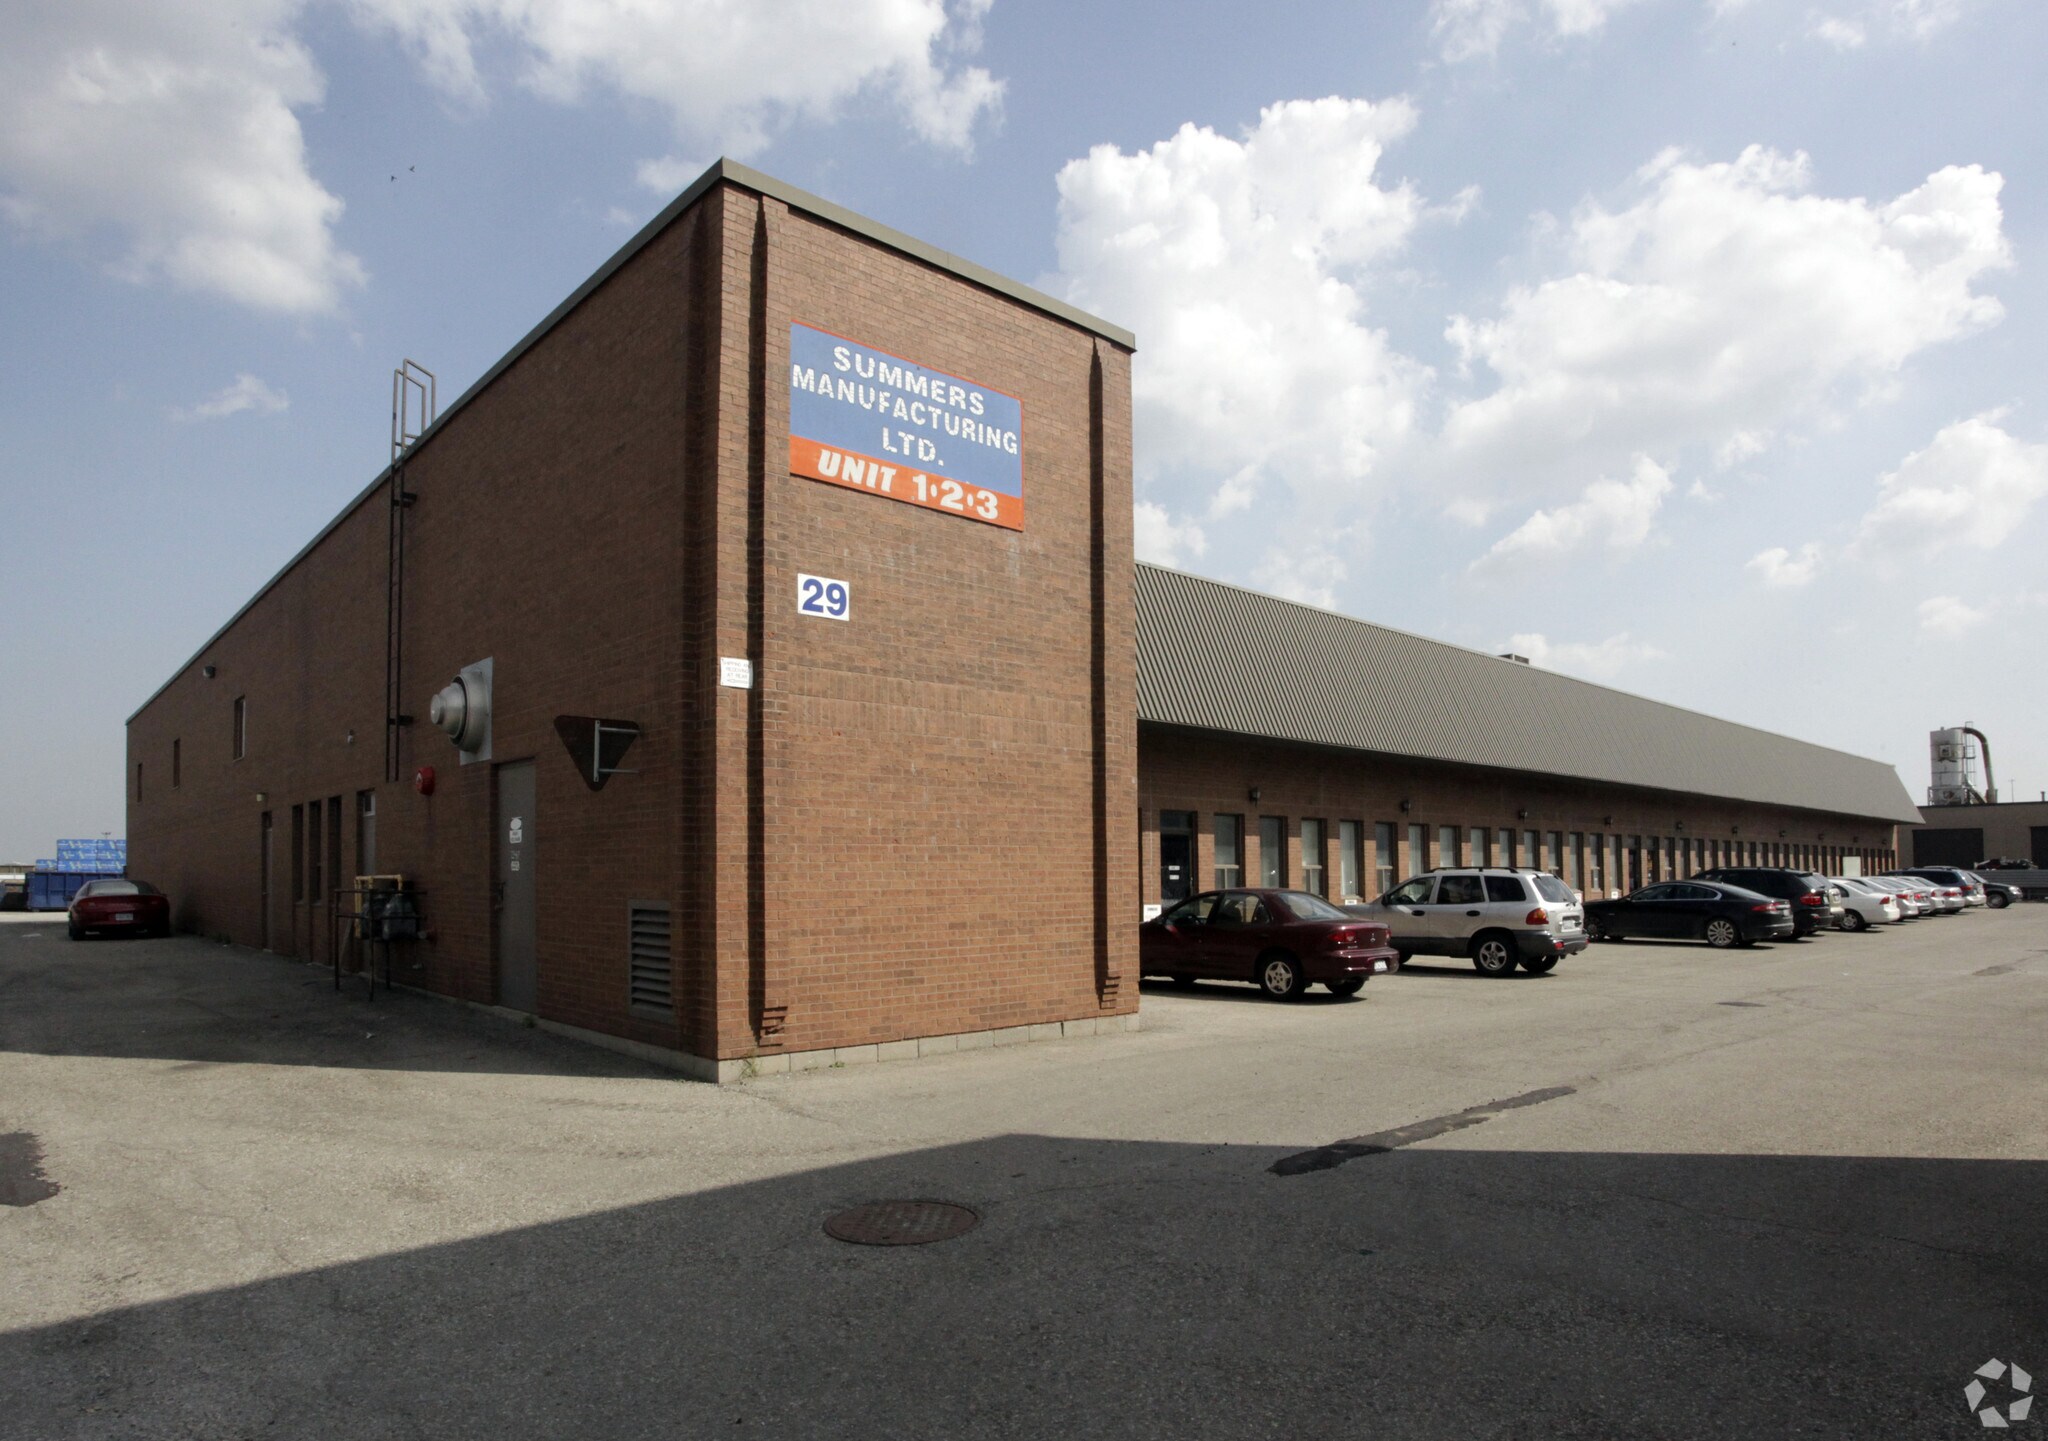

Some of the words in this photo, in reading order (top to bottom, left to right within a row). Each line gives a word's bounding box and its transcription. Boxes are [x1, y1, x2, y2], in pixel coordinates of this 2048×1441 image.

[833, 346, 984, 415] SUMMERS
[792, 364, 1018, 455] MANUFACTURING
[882, 427, 944, 466] LTD.
[817, 449, 897, 493] UNIT
[802, 578, 847, 617] 29
